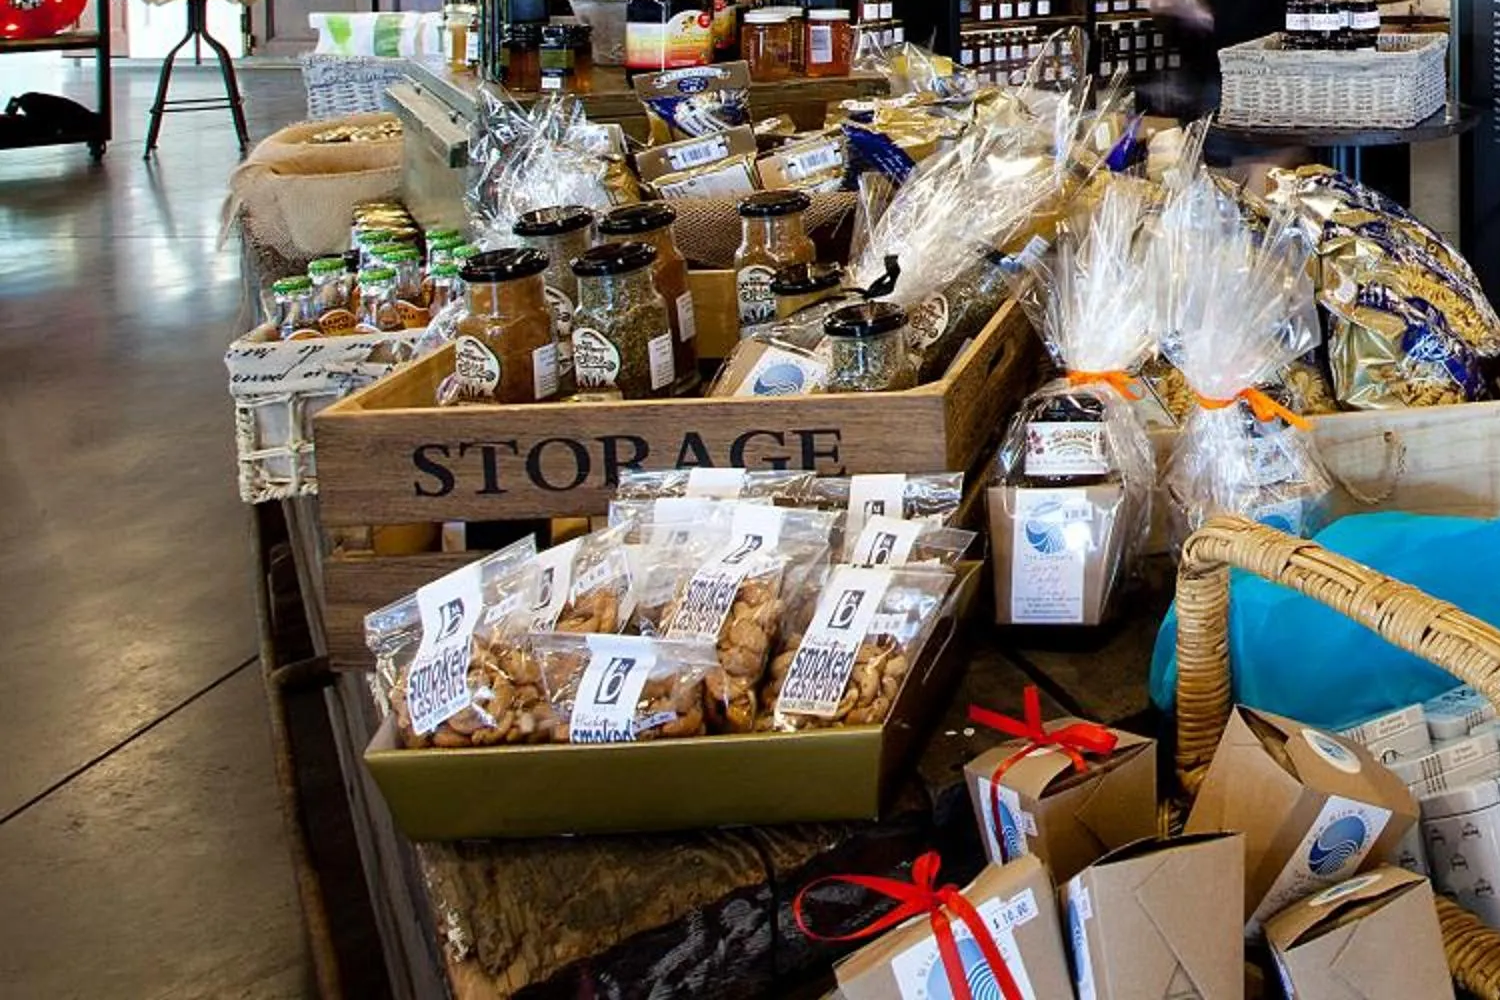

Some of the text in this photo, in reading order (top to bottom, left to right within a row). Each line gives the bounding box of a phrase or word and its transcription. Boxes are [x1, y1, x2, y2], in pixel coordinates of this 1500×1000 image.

[412, 428, 846, 497] STORAGE
[409, 635, 470, 700] smoked
[788, 643, 860, 682] smoked
[412, 678, 466, 721] cashews
[571, 718, 634, 744] smoked
